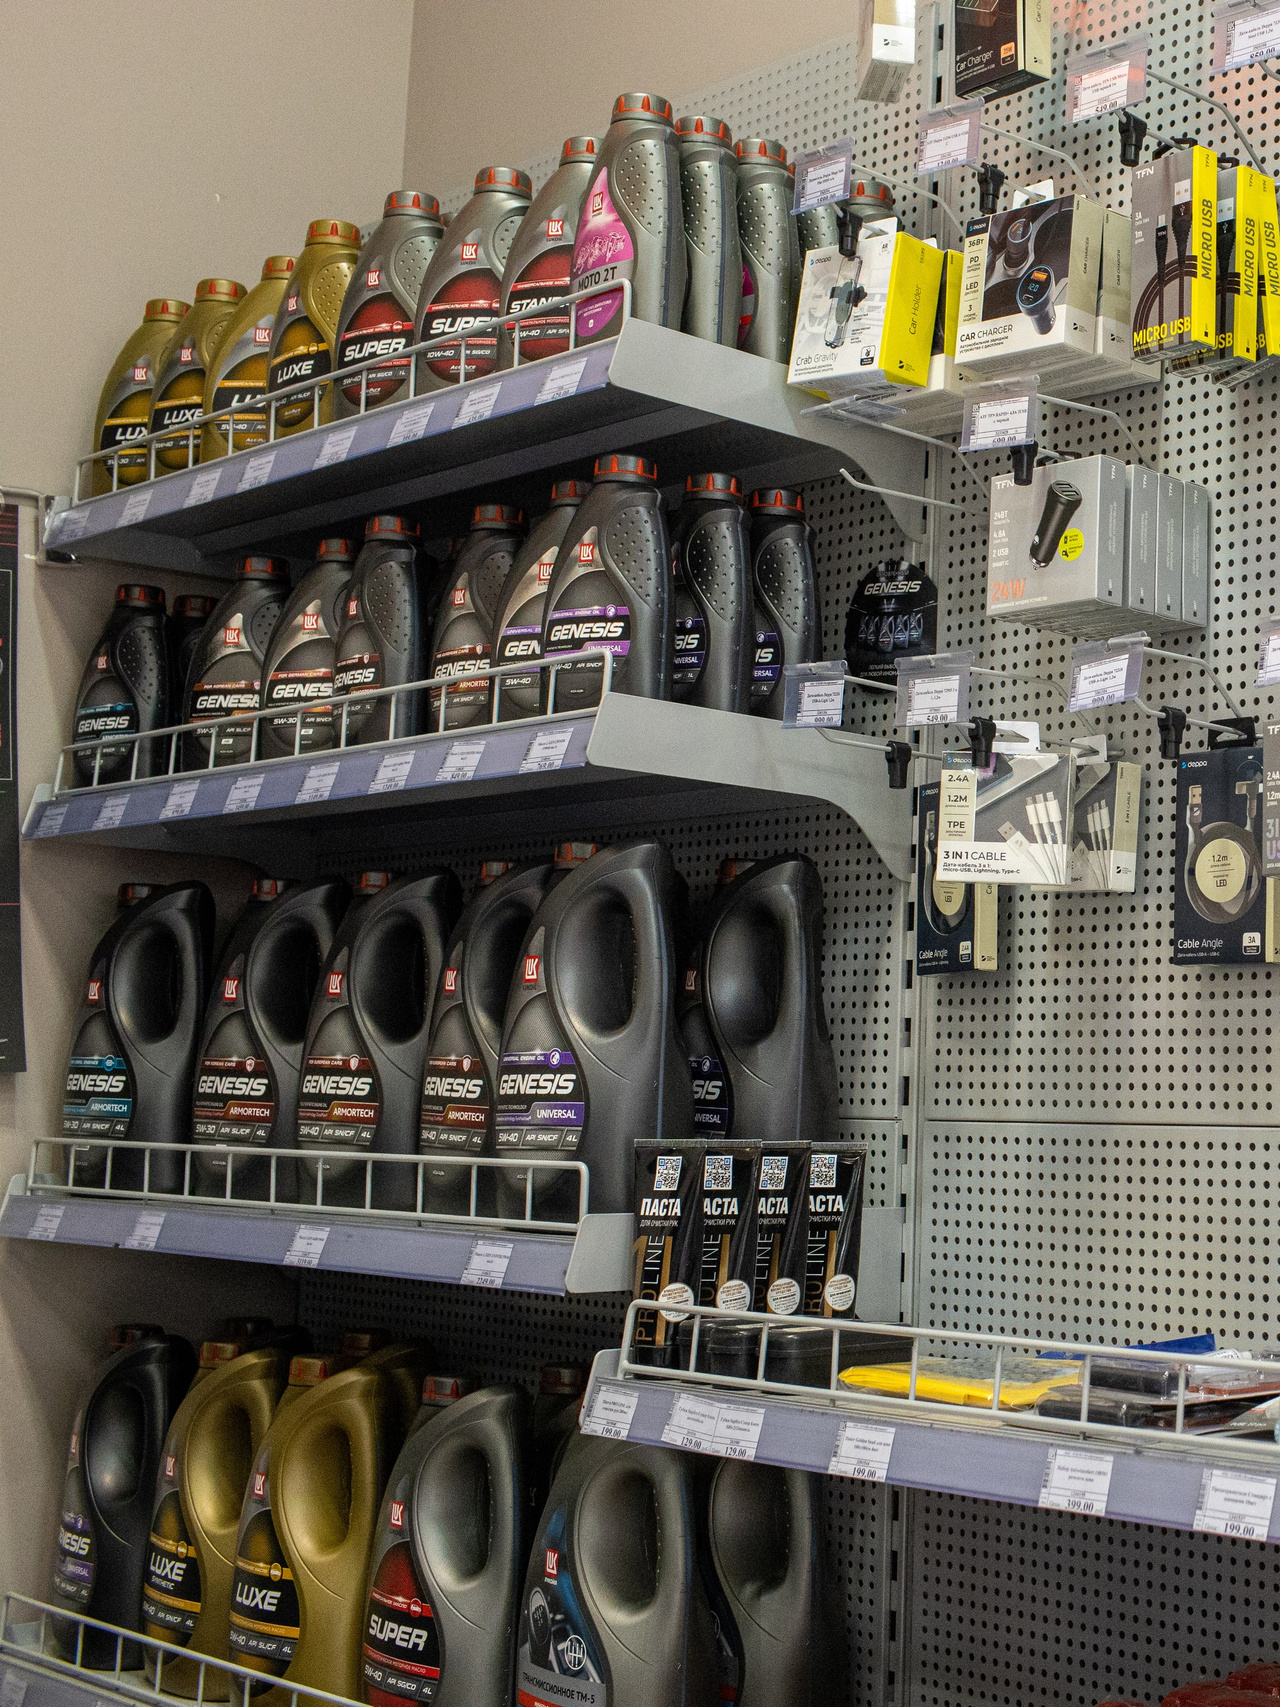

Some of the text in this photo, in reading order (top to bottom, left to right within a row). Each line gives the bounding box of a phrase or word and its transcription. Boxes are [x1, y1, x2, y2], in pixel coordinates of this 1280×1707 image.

[956, 50, 994, 72] Car Charger
[1135, 166, 1155, 179] TFN
[968, 238, 985, 248] 36Вт
[1201, 198, 1214, 281] MICRO USB
[1263, 221, 1276, 249] USB
[969, 254, 980, 264] PD
[1244, 216, 1256, 298] MICRO USB
[578, 266, 618, 293] MOTO 2T
[965, 280, 979, 291] LED
[909, 284, 923, 336] Car Holder
[959, 324, 1014, 343] CAR CHARGER
[1133, 316, 1192, 347] MICRO USB
[343, 337, 406, 363] SUPER
[795, 351, 839, 366] Crab Gravity
[277, 359, 316, 384] LUXE
[863, 580, 923, 596] GENESIS
[991, 577, 1028, 602] 24W
[551, 622, 625, 642] GENESIS
[334, 668, 376, 688] GENESIS
[435, 659, 491, 680] GENESIS
[77, 716, 130, 734] GENESIS
[1187, 759, 1208, 769] deppa
[947, 773, 970, 783] 2.4A
[947, 794, 968, 803] 1.2M
[1266, 790, 1280, 801] 1.2m
[947, 820, 966, 829] TPE
[943, 850, 1007, 862] 3 IN 1 CABLE
[1215, 878, 1228, 888] LED
[1177, 936, 1224, 949] Cable Angle
[66, 1073, 127, 1094] GENESIS
[197, 1076, 269, 1097] GENESIS
[302, 1075, 373, 1096] GENESIS
[424, 1077, 484, 1099] GENESIS
[498, 1073, 577, 1096] GENESIS
[90, 1102, 128, 1113] ARMORTECH
[229, 1106, 270, 1118] ARMORTECH
[536, 1108, 577, 1120] UNIVERSAL
[566, 1134, 578, 1143] 4L
[639, 1197, 682, 1217] ПАСТА
[601, 1425, 622, 1439] 199.00
[681, 1435, 702, 1450] 129.00
[724, 1445, 747, 1458] 129.00
[851, 1465, 878, 1480] 199.00
[1063, 1498, 1095, 1514] 399.00
[1222, 1521, 1256, 1538] 199.00
[149, 1551, 188, 1583] LUXE
[235, 1582, 283, 1612] LUXE
[368, 1612, 429, 1653] SUPER
[522, 1672, 596, 1705] ТРАНСМИССИОННОЕ ТМ-5
